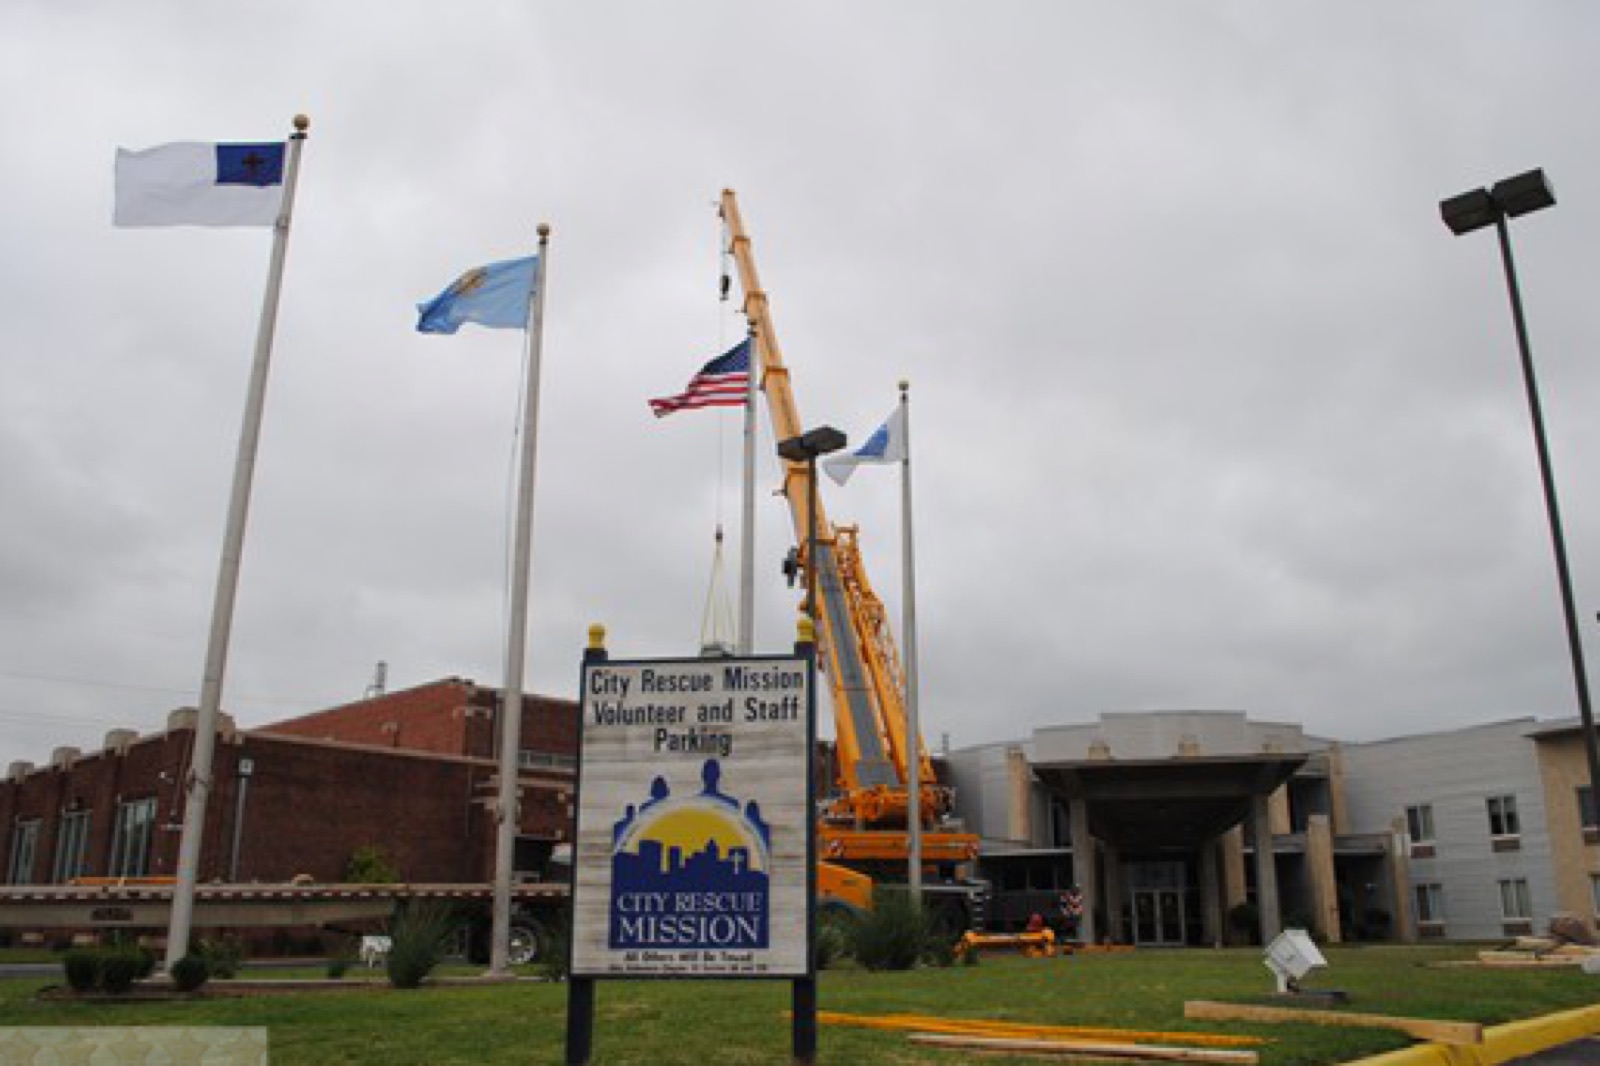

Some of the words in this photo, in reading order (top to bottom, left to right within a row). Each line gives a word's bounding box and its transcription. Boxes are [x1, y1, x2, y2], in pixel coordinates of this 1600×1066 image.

[591, 669, 631, 697] City
[641, 669, 713, 692] Rescue
[723, 667, 803, 691] Mission
[595, 702, 686, 725] Volunteer
[697, 698, 733, 722] and
[745, 697, 799, 720] Staff
[654, 728, 732, 756] Parking
[617, 892, 668, 911] CITY
[675, 892, 761, 911] RESCUE
[618, 916, 760, 943] MISSION
